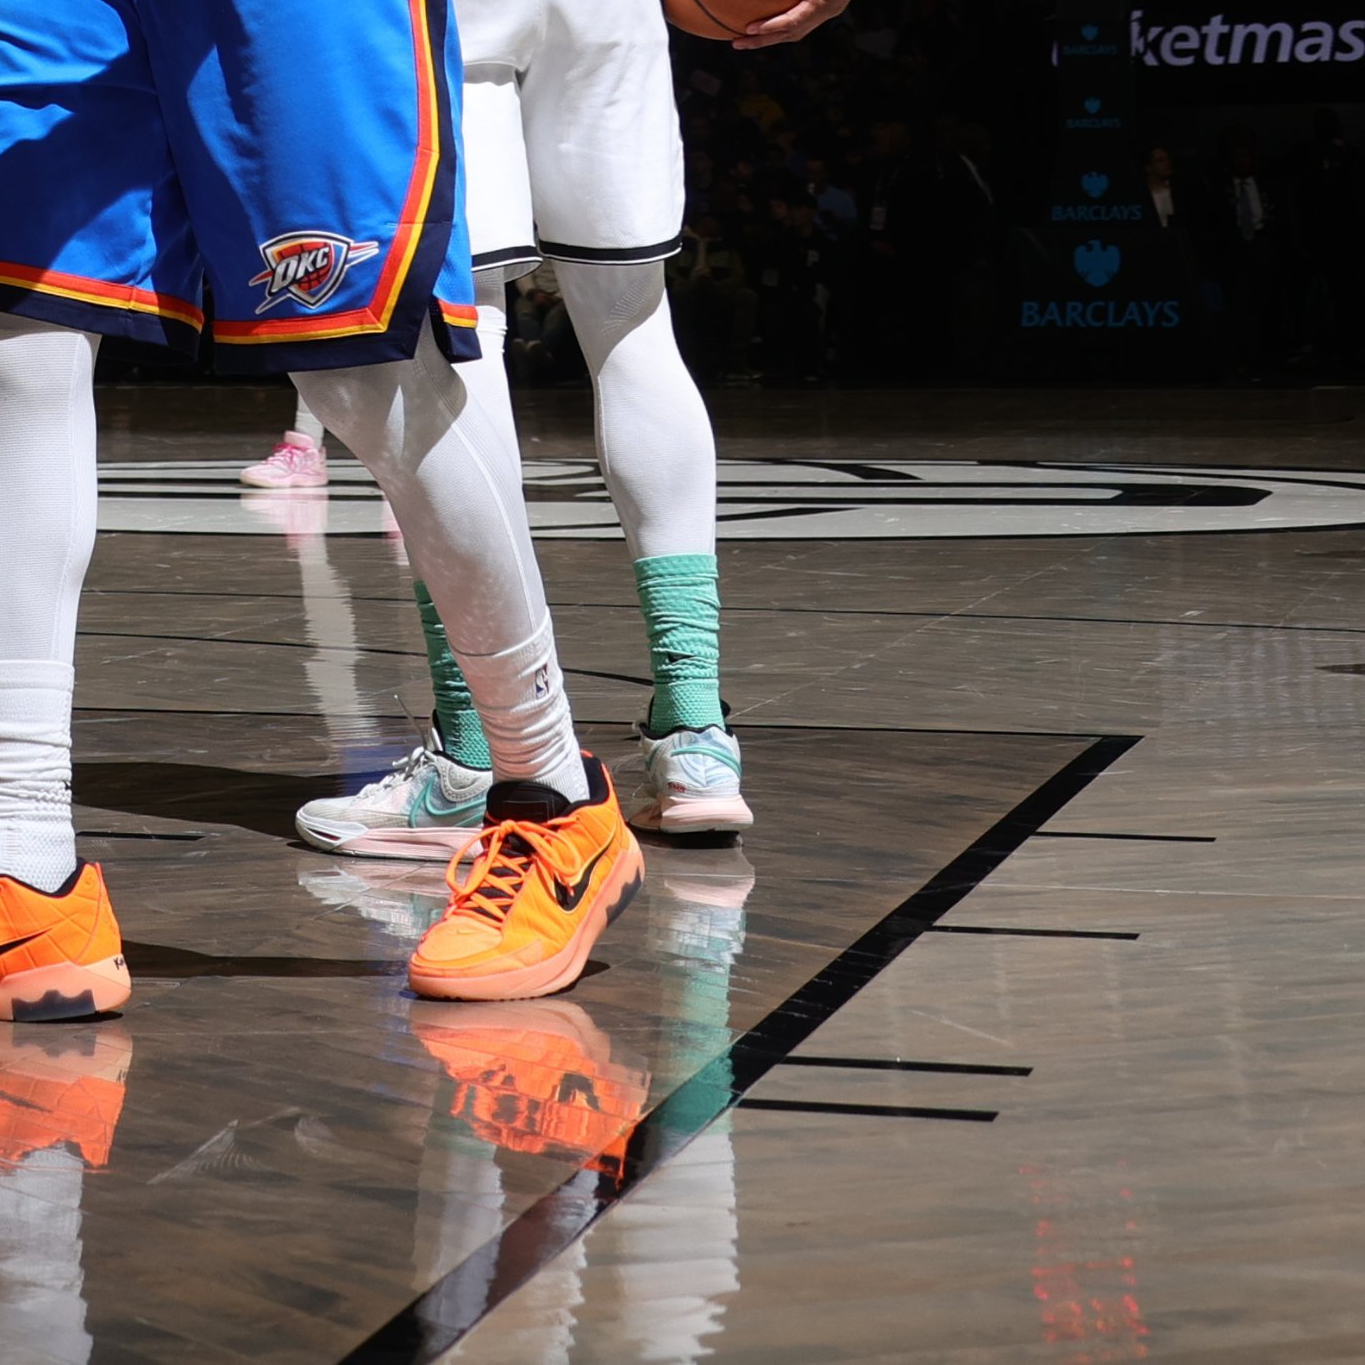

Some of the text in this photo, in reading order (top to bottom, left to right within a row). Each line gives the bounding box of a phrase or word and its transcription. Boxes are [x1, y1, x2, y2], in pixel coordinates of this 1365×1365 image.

[1050, 204, 1143, 222] BARCLAYS
[269, 246, 331, 295] OKC
[1019, 299, 1182, 329] BARCLAYS
